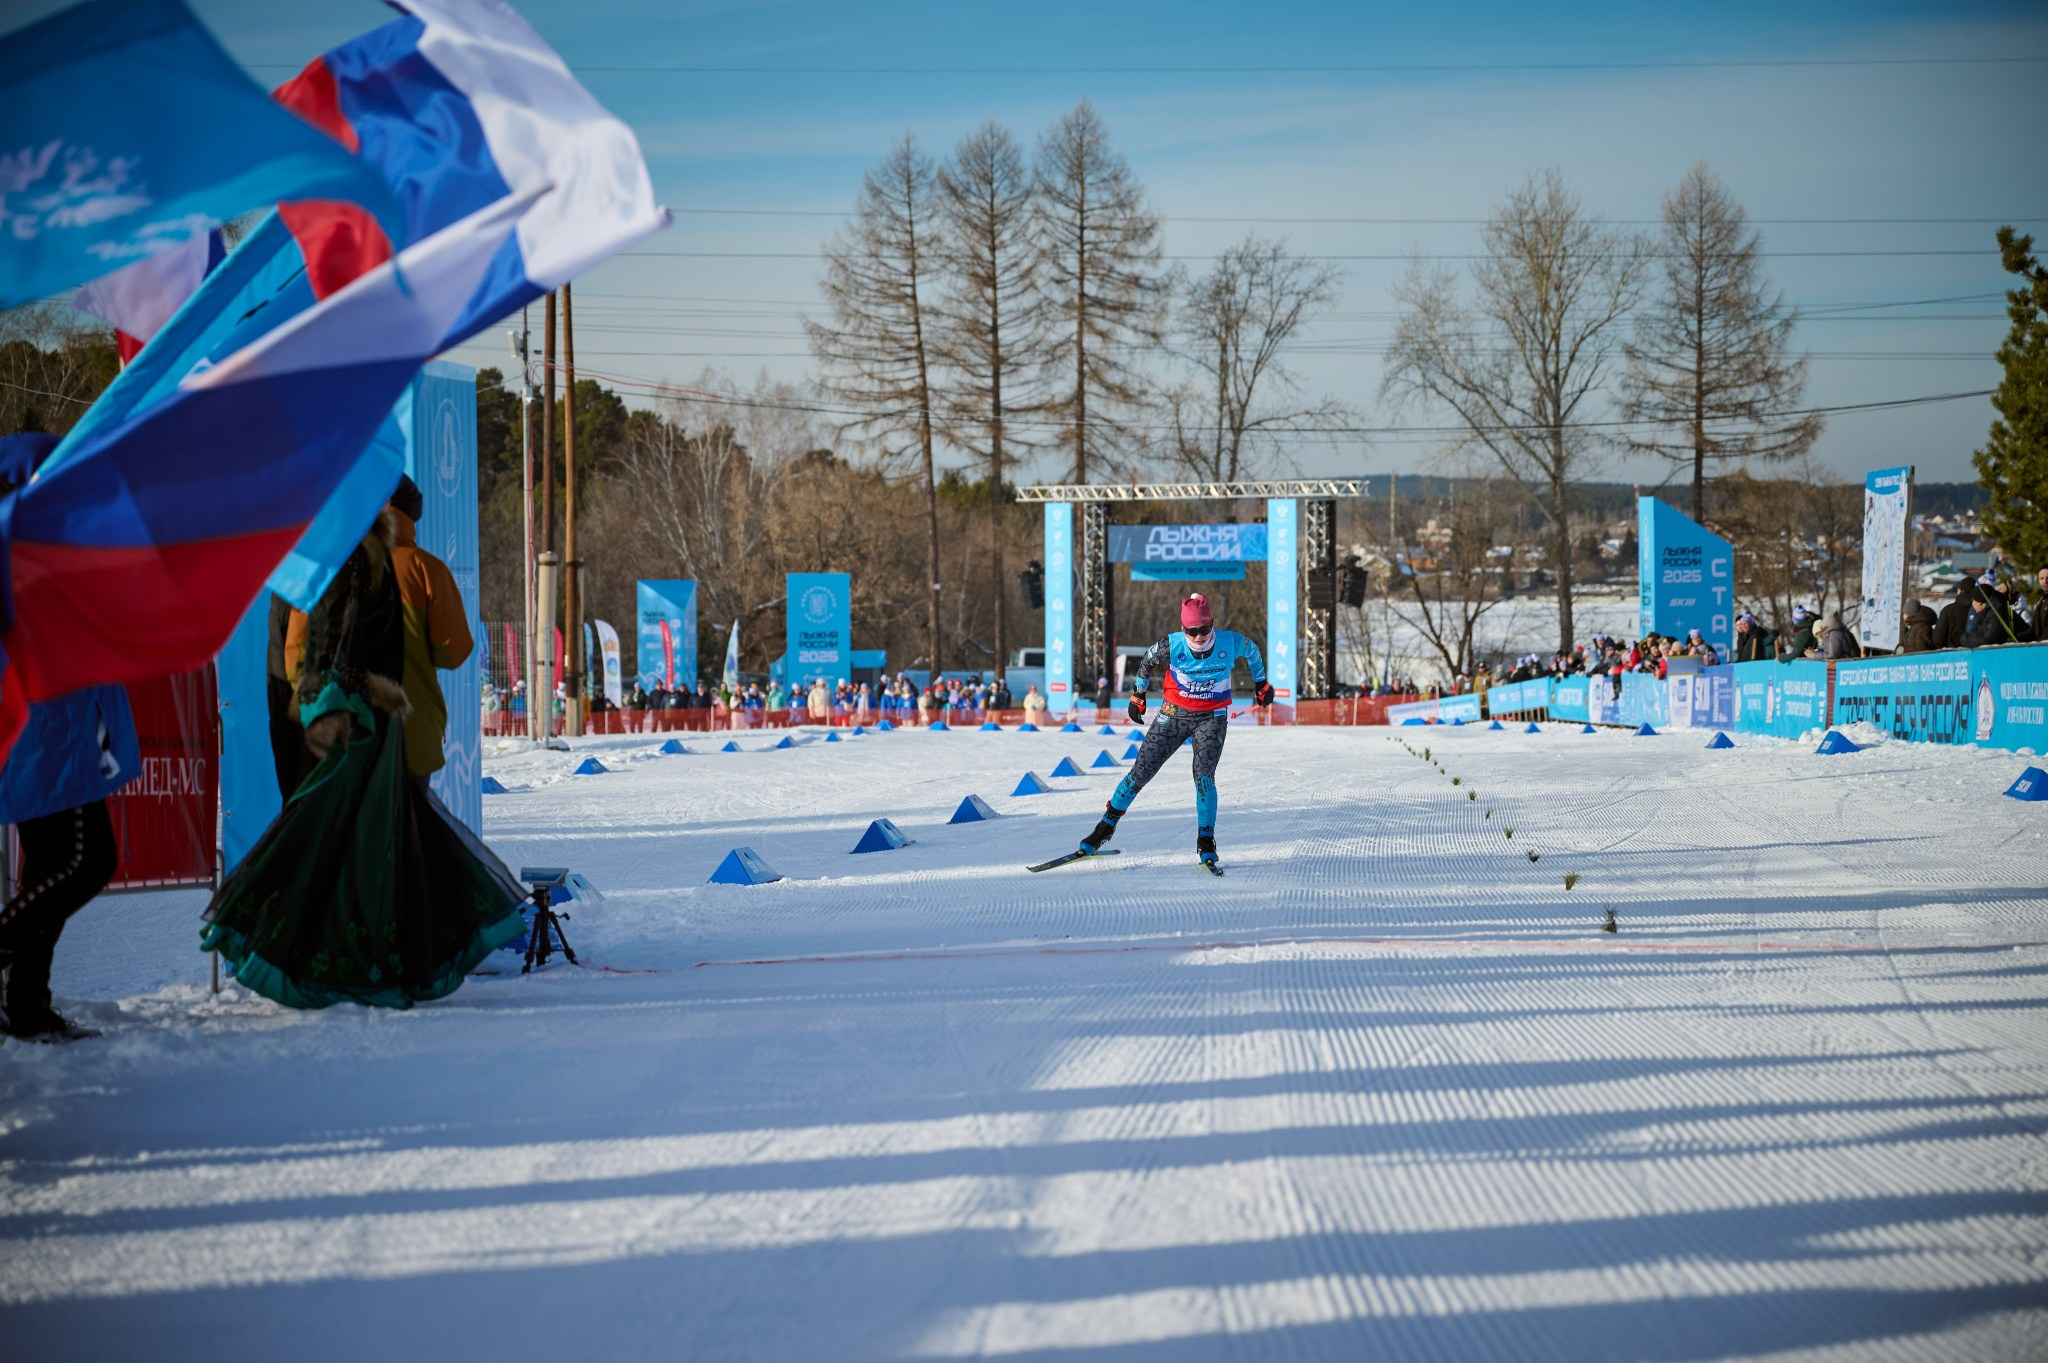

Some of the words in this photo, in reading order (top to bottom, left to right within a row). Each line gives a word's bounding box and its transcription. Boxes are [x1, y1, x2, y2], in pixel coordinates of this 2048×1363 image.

[1148, 526, 1238, 542] ЛЫЖНЯ
[1145, 543, 1242, 560] РОССИИ
[1662, 547, 1702, 557] ЛЫЖНЯ
[1662, 558, 1702, 567] РОССИИ
[1662, 569, 1702, 583] 2025
[799, 631, 839, 639] ЛЫЖНЯ
[798, 641, 839, 649] РОССИИ
[798, 651, 839, 663] 2025
[1893, 695, 1918, 741] ВСЯ
[1920, 694, 1970, 744] РОССИЯ
